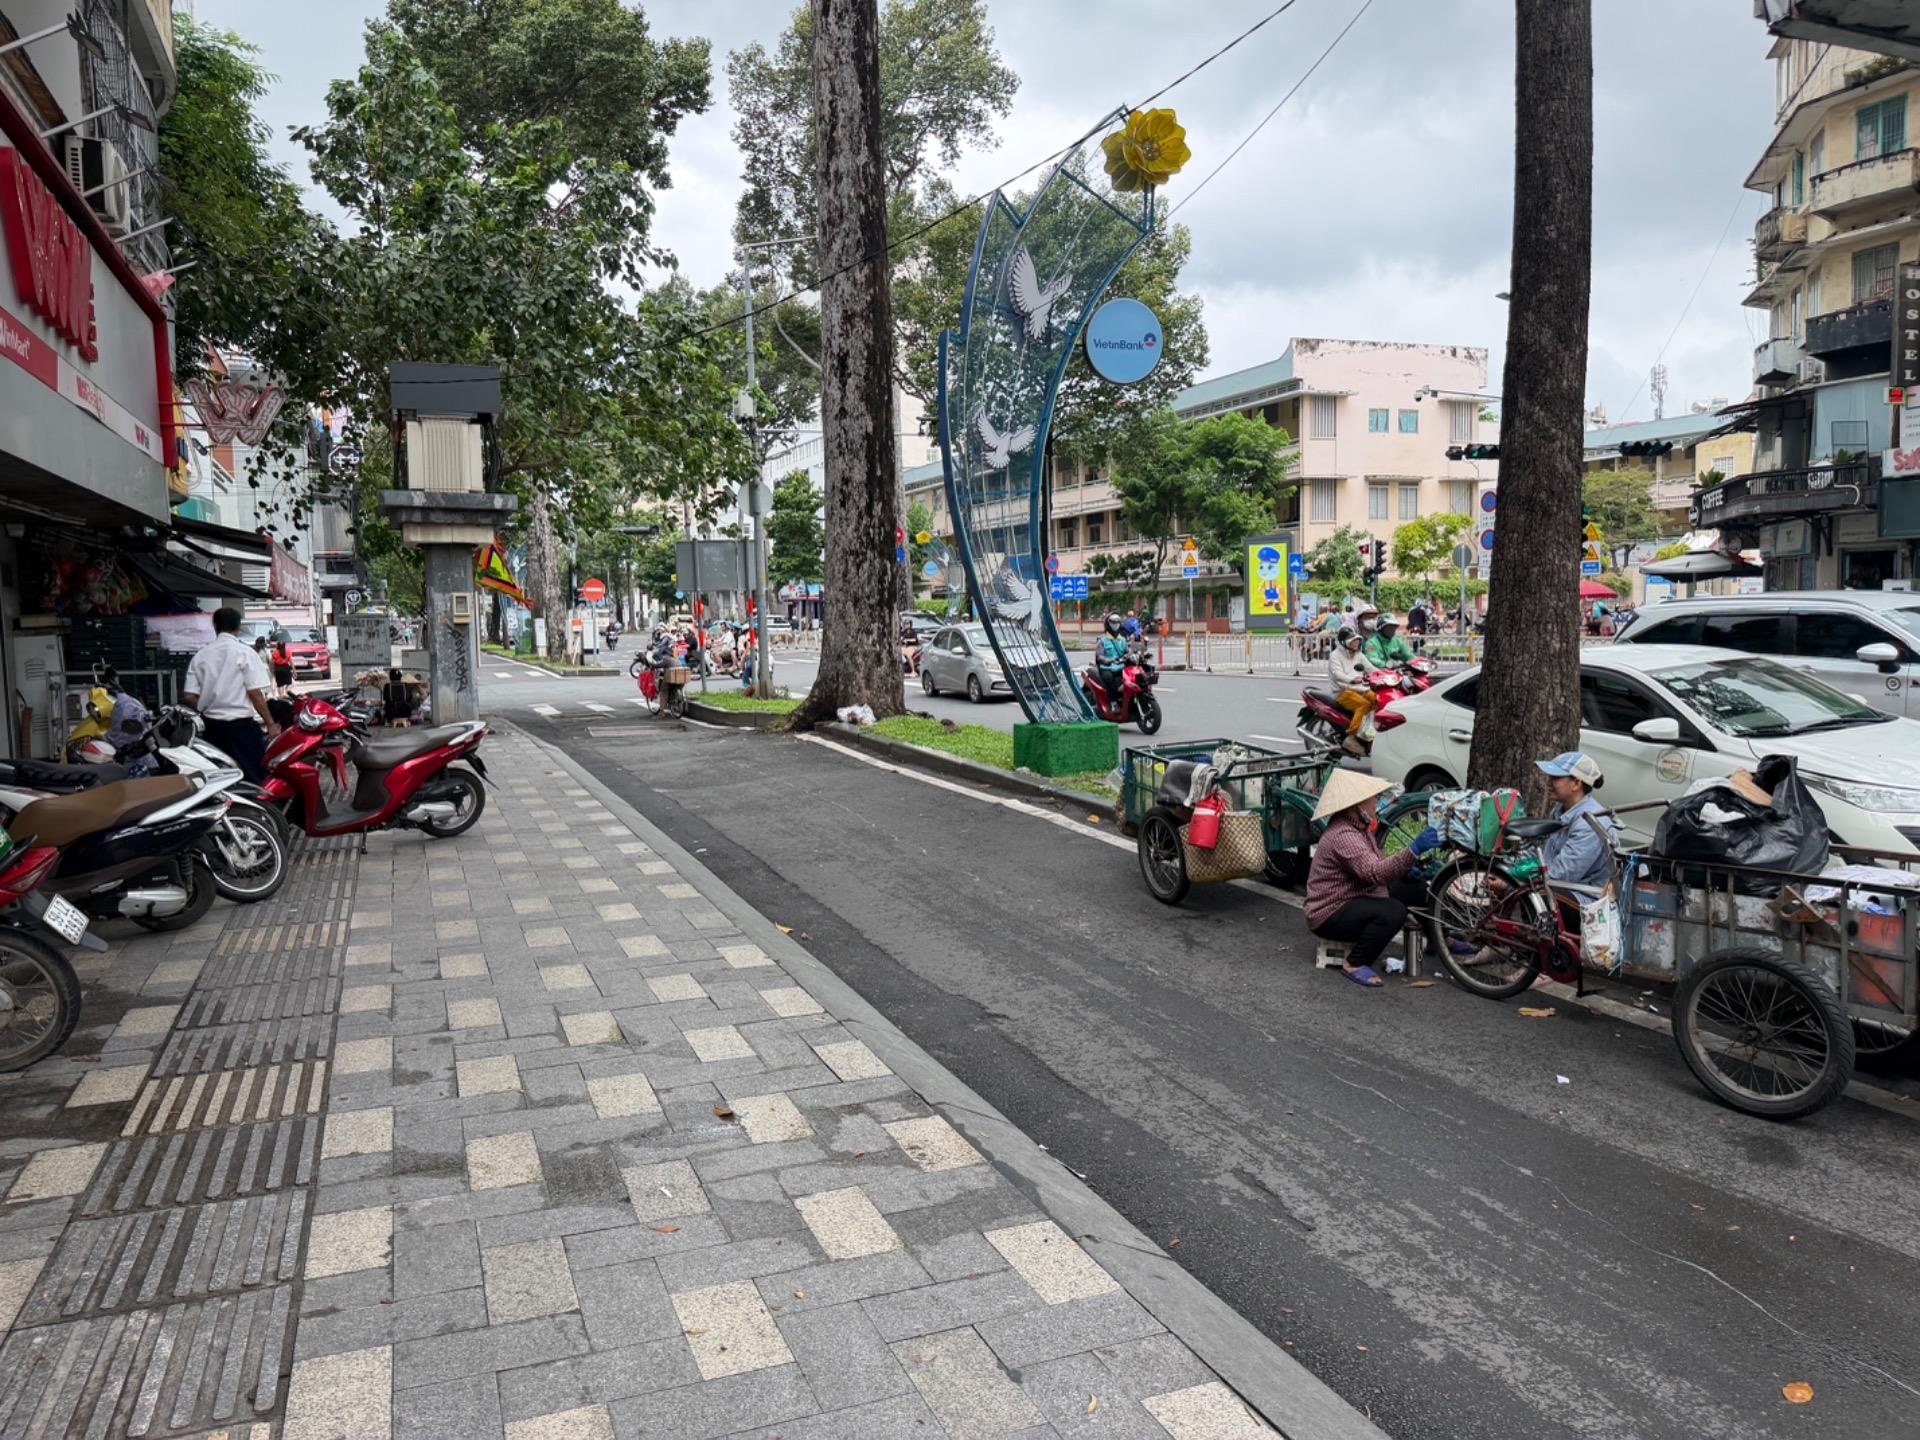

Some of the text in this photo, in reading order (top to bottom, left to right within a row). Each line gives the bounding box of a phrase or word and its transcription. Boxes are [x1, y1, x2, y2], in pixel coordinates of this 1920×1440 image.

[1904, 268, 1920, 381] HOSTEL
[1093, 338, 1145, 351] VietinBank
[1701, 488, 1724, 510] COFFEE
